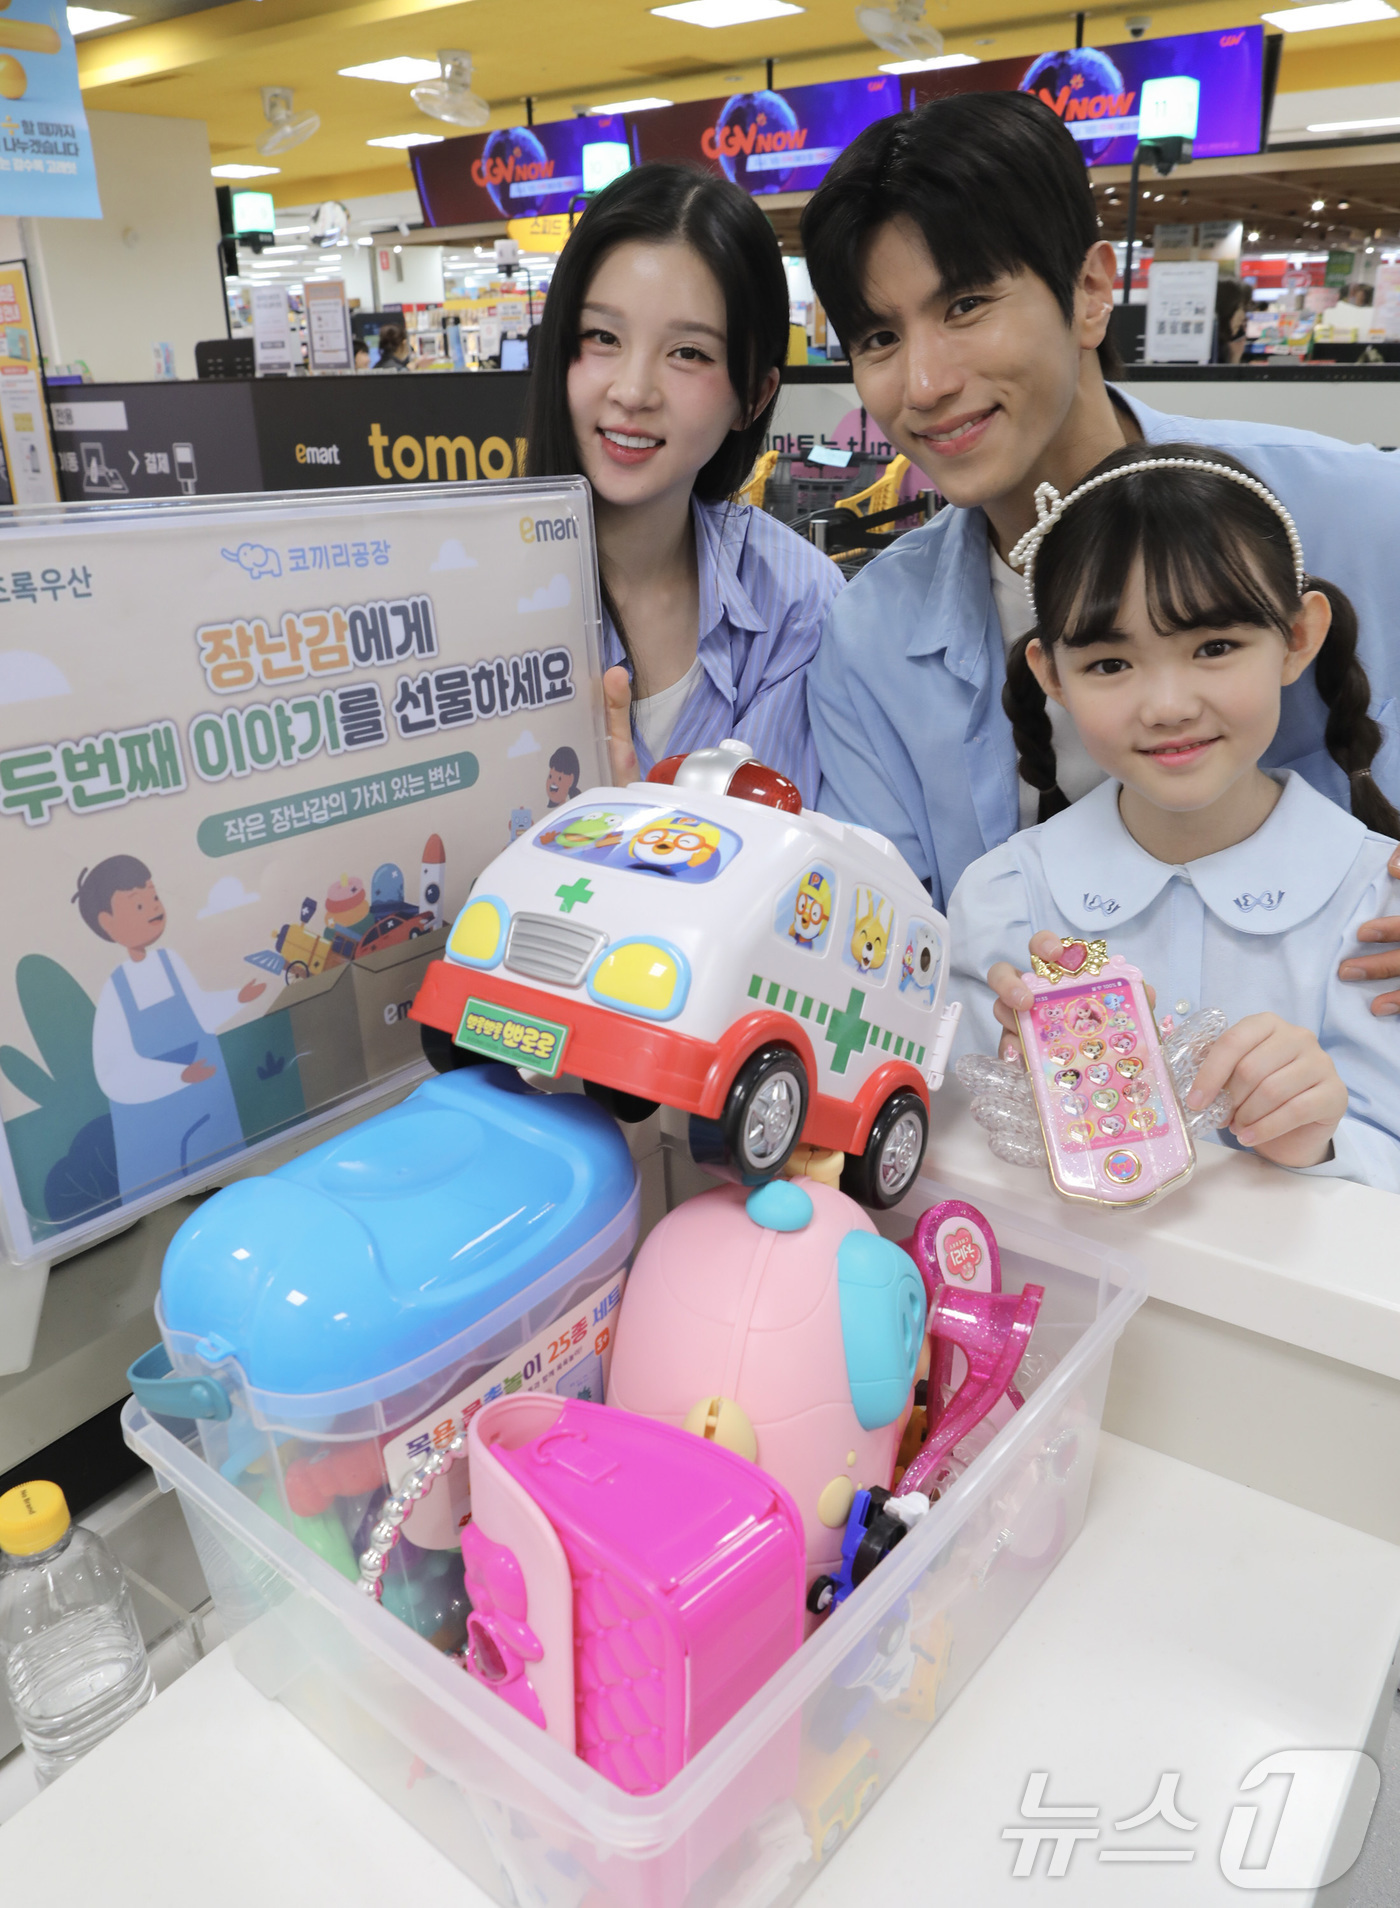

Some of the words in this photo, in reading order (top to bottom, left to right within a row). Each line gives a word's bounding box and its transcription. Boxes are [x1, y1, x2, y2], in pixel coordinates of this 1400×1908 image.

[1065, 92, 1136, 121] NOW
[3, 136, 80, 156] 나누겠습니다
[701, 123, 758, 159] CGV
[755, 129, 808, 153] NOW
[471, 155, 515, 187] CGV
[515, 160, 555, 181] NOW
[295, 444, 341, 465] emart
[519, 513, 579, 543] emart
[288, 540, 391, 572] 코끼리공장
[201, 599, 435, 690] 장난감에게
[0, 726, 183, 820] 두번째
[193, 685, 385, 778] 이야기를
[395, 651, 574, 734] 선물하세요
[223, 811, 267, 844] 작은
[270, 791, 348, 832] 장난감의
[351, 781, 388, 811] 가치
[390, 770, 425, 801] 있는
[428, 761, 461, 792] 변신
[502, 1020, 557, 1059] 뽀로로
[950, 1243, 975, 1266] 체리
[547, 1315, 588, 1364] 25종
[592, 1285, 620, 1326] 세트
